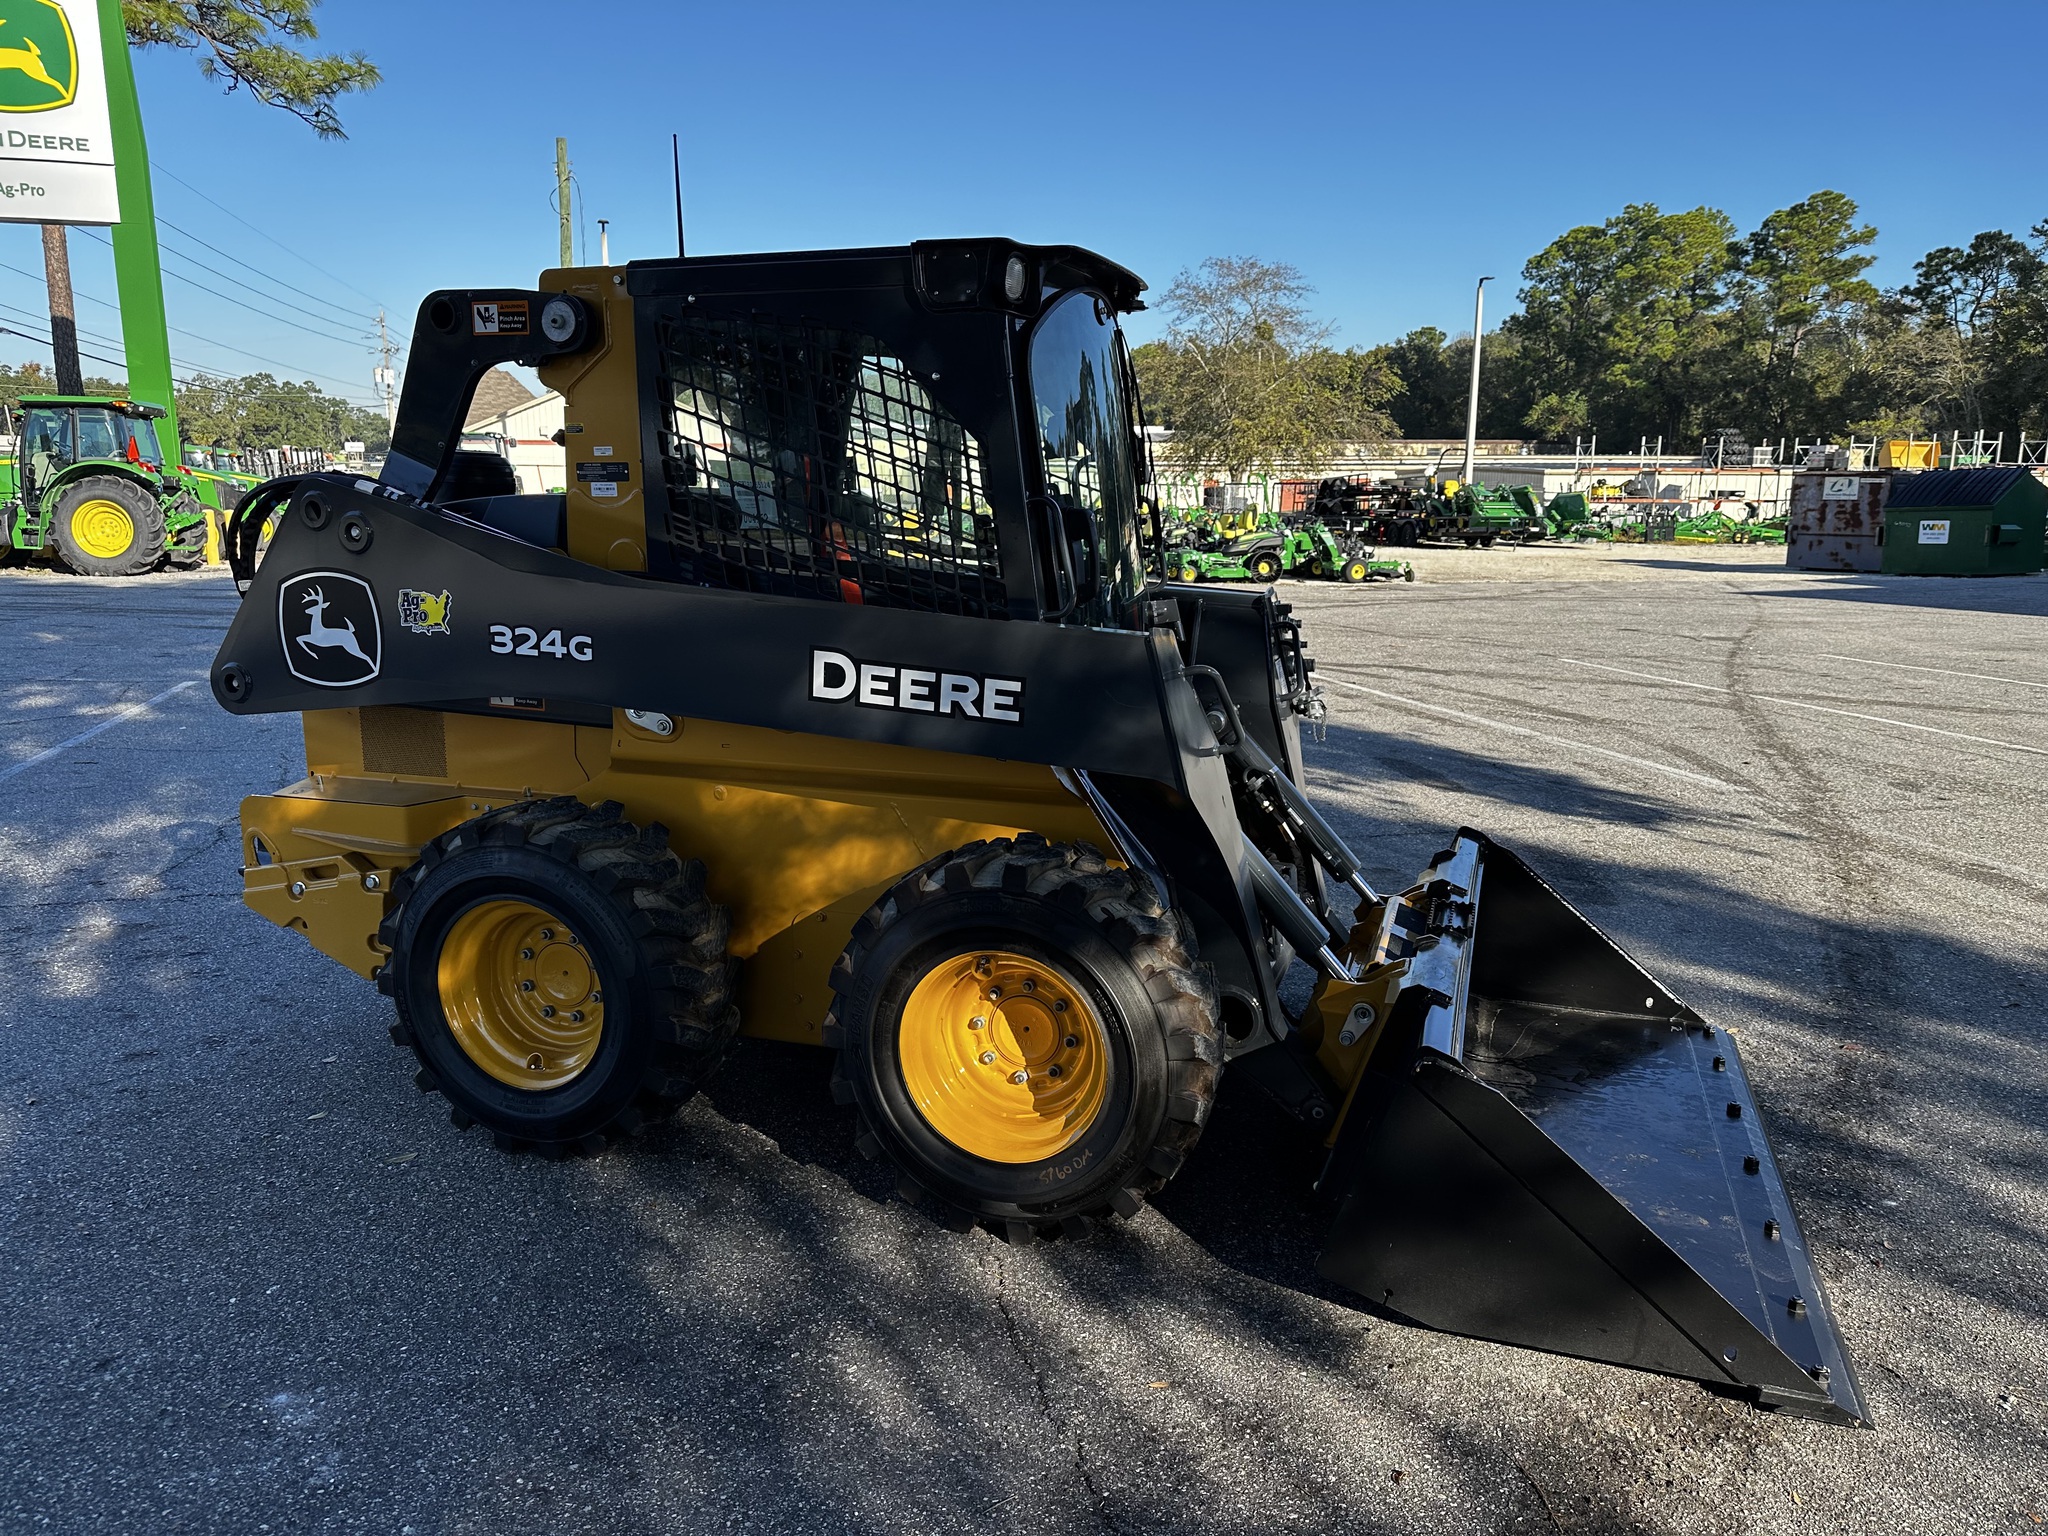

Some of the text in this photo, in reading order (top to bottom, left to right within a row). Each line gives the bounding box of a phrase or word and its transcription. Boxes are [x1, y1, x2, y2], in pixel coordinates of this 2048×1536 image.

[7, 130, 90, 152] DEERE
[402, 608, 428, 623] Pro
[489, 624, 593, 661] 324G
[812, 650, 1022, 722] DEERE
